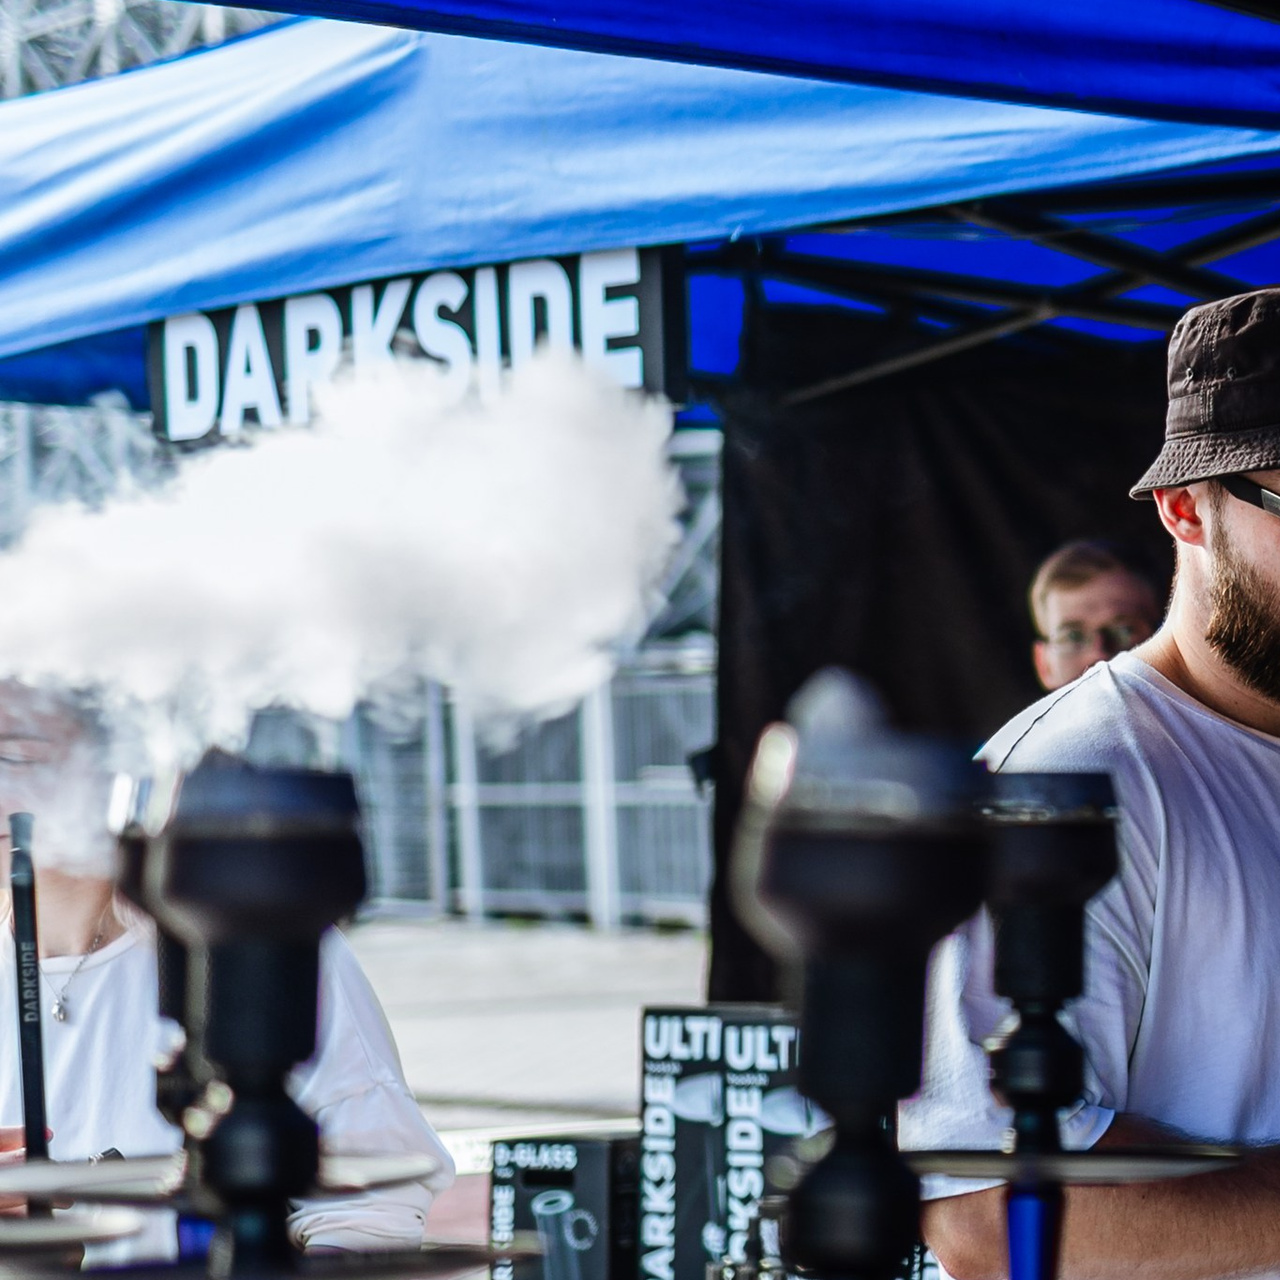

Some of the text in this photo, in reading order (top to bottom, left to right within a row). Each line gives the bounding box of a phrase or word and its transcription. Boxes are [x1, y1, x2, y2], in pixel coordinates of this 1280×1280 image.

[163, 247, 645, 442] DARKSIDE
[21, 941, 39, 1023] DARKSIDE
[725, 1025, 800, 1071] ULT
